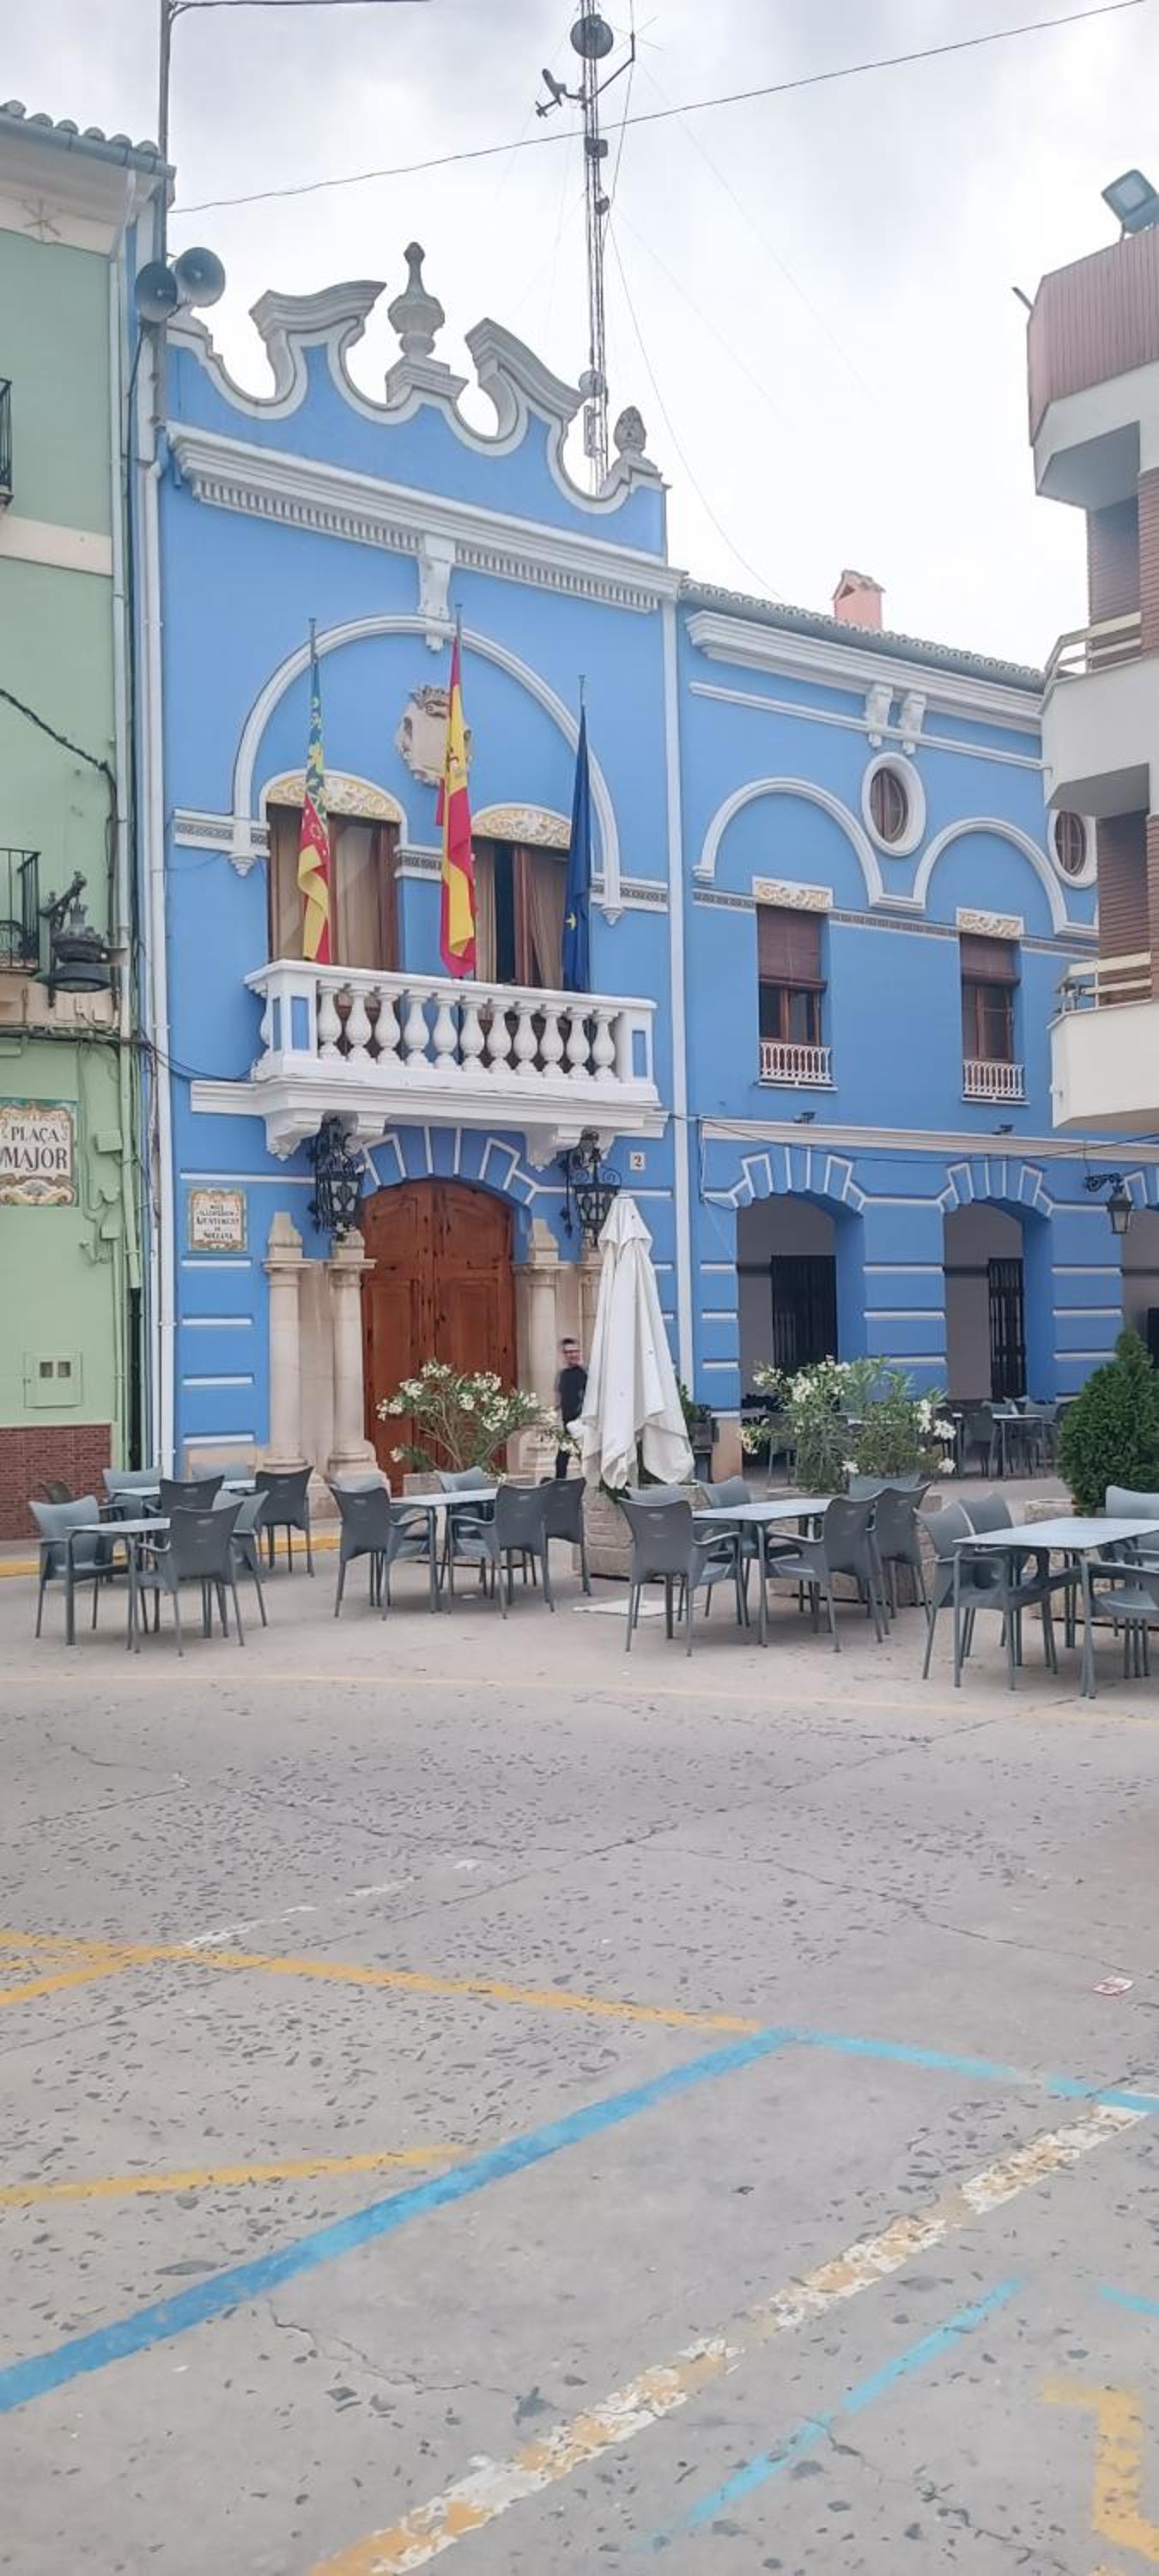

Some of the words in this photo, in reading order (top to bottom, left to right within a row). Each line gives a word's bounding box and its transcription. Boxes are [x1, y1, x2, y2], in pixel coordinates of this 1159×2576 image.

[11, 1126, 59, 1144] PLAÇA
[3, 1146, 68, 1171] MAJOR
[634, 1154, 642, 1168] 2
